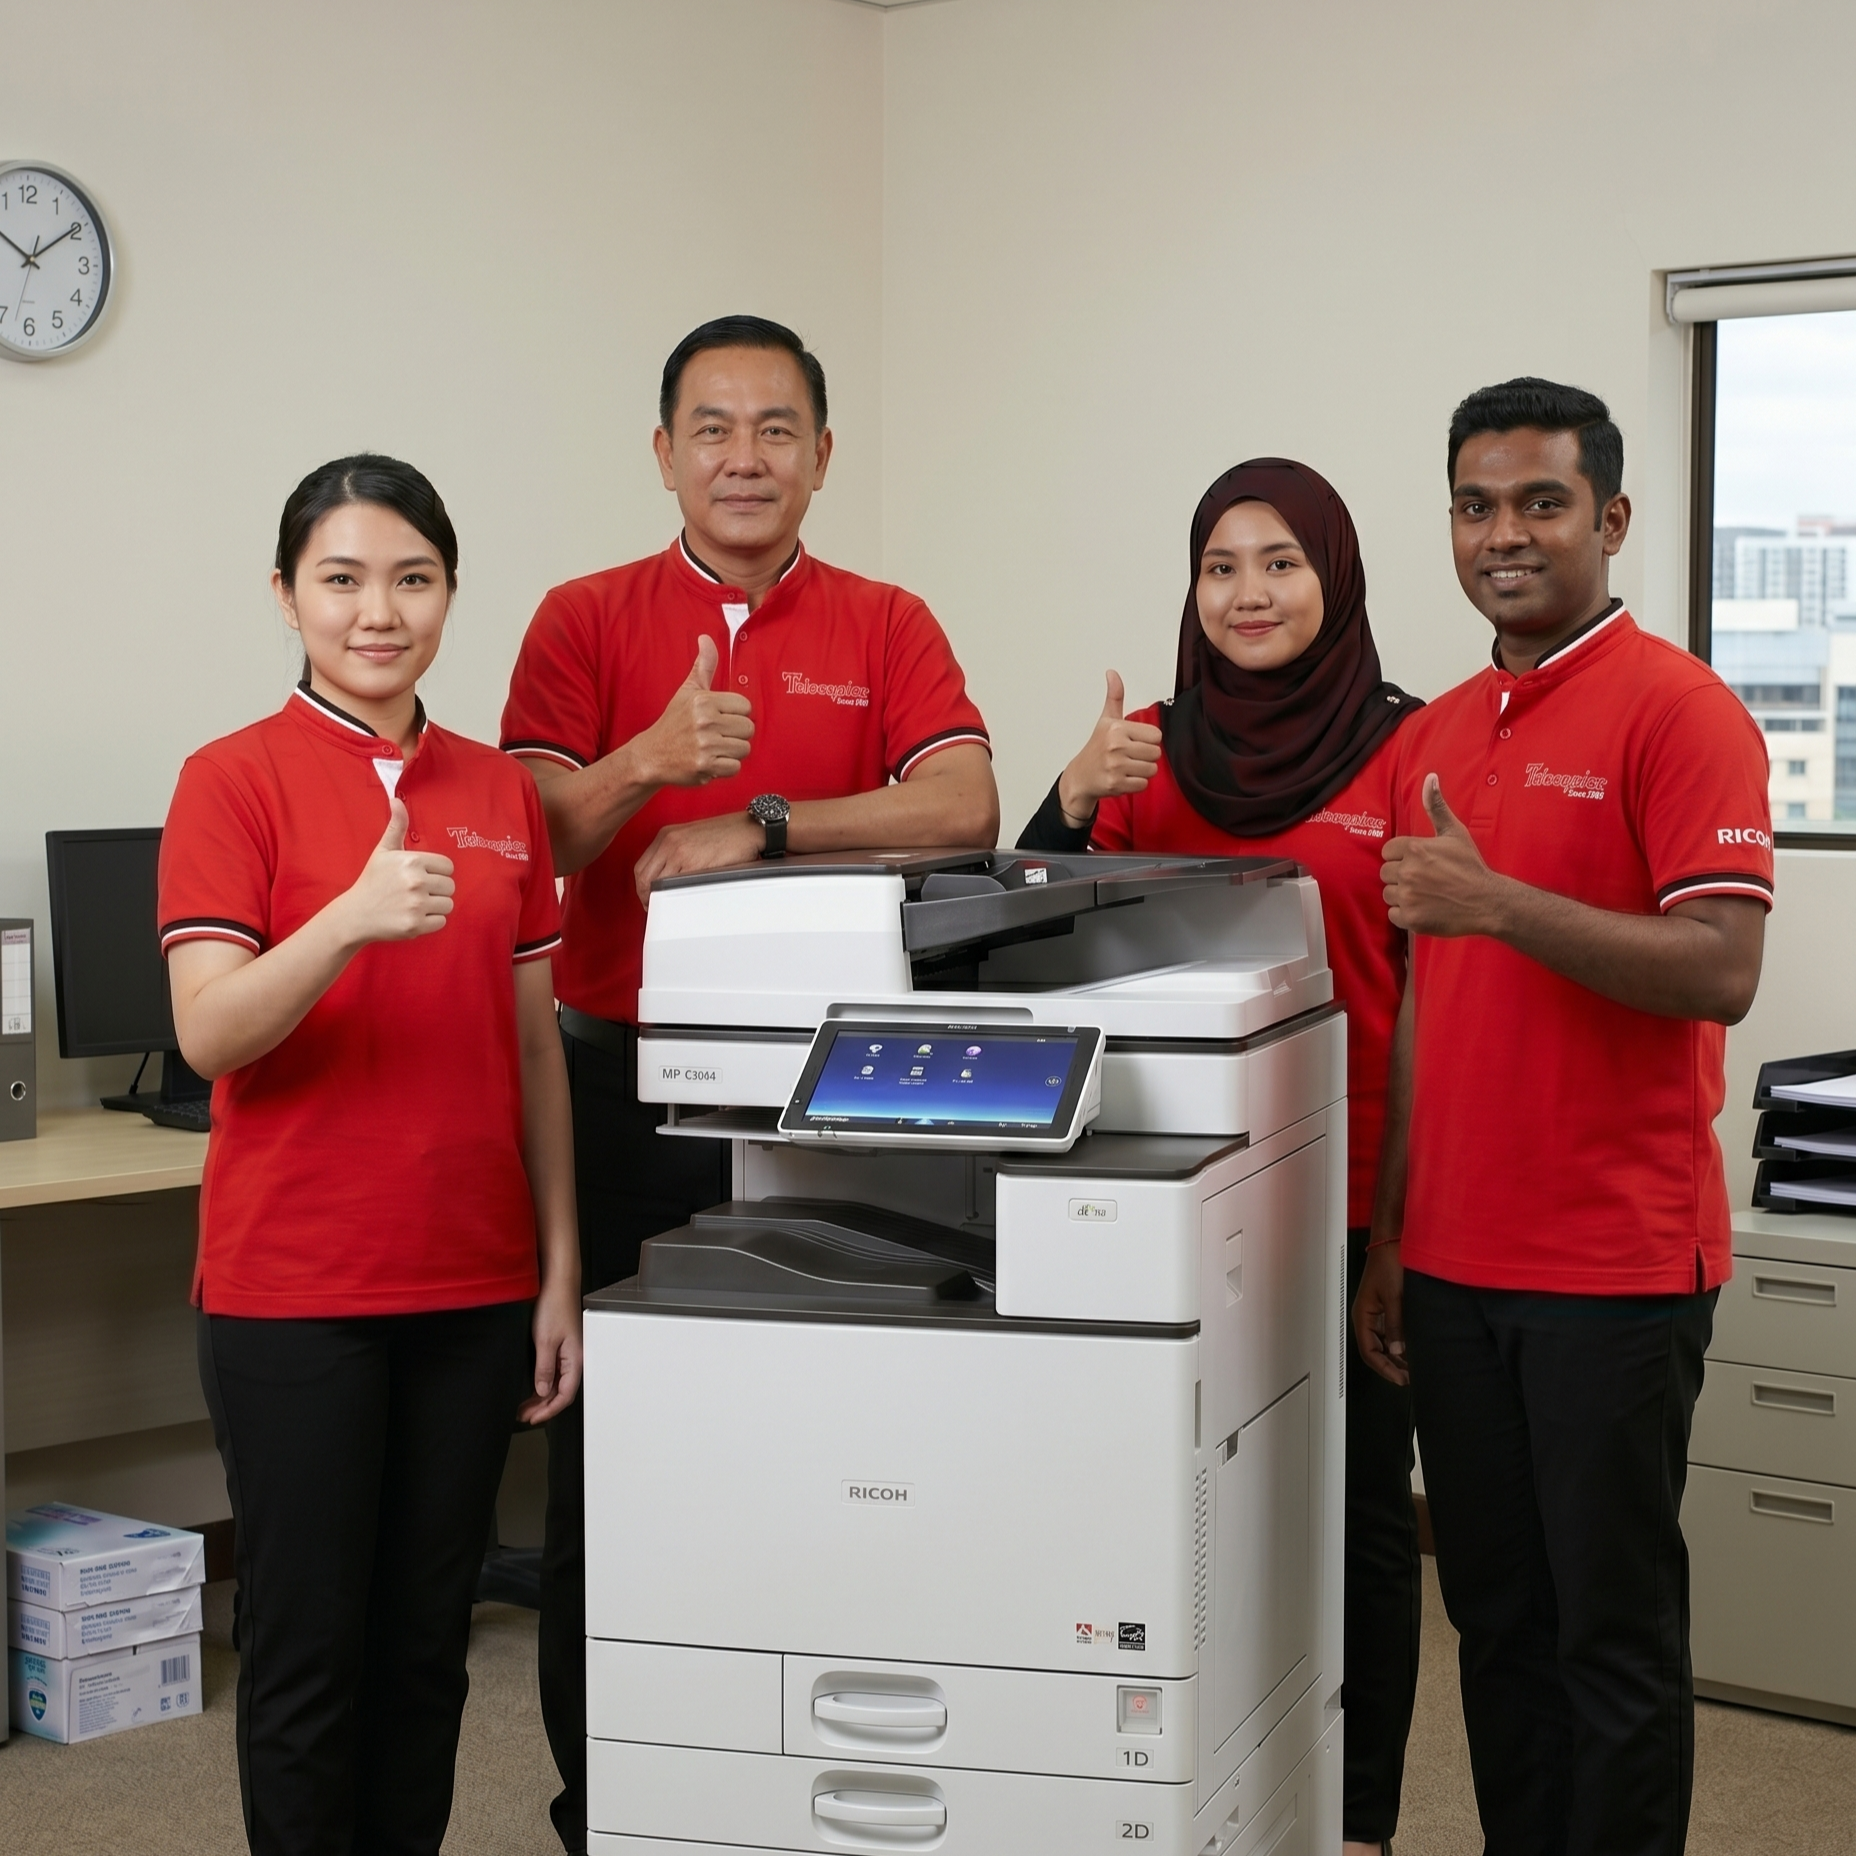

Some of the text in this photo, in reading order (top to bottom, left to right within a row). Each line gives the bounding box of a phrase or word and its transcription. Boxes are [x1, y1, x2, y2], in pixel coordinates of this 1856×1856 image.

[18, 184, 38, 204] 12
[52, 196, 59, 215] 1
[70, 221, 82, 240] 2
[78, 256, 90, 275] 3
[70, 288, 82, 307] 4
[23, 317, 35, 337] 6
[52, 310, 63, 329] 5
[662, 1068, 680, 1079] MP
[849, 1486, 908, 1501] RICOH
[1123, 1751, 1149, 1767] 1D
[1122, 1823, 1150, 1839] 2D
